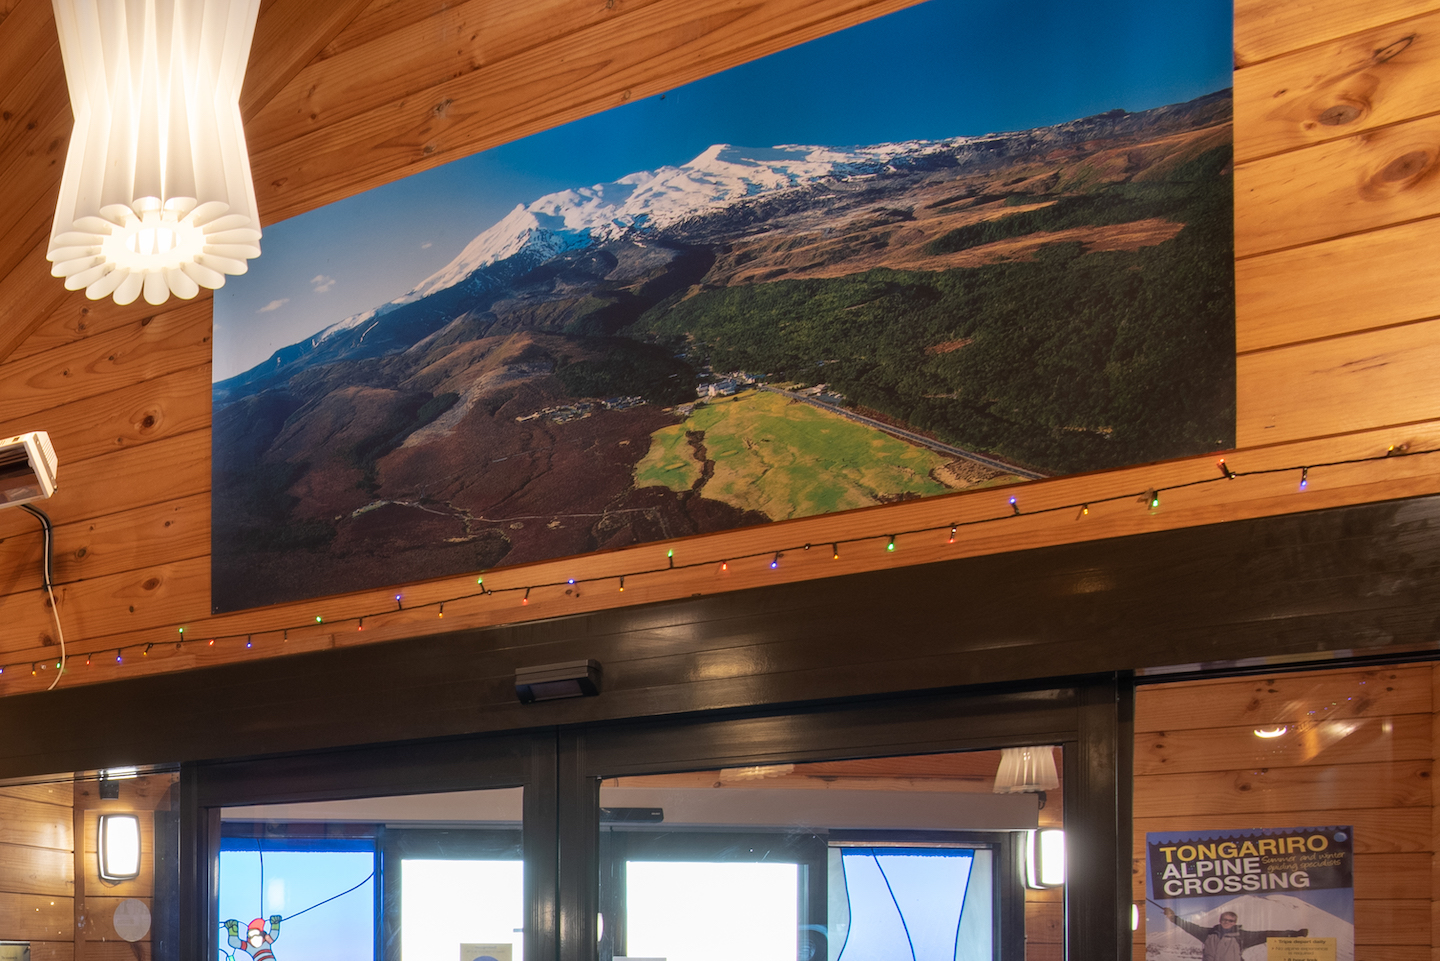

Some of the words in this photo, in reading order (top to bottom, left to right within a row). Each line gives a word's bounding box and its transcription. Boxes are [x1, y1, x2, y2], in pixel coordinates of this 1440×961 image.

[1159, 834, 1329, 864] TONGARIRO
[1261, 855, 1297, 865] Summer
[1299, 853, 1317, 862] and
[1318, 851, 1346, 860] winter
[1162, 857, 1262, 881] ALPINE
[1267, 862, 1299, 873] guiding
[1300, 859, 1342, 870] specialists
[1163, 871, 1311, 898] CROSSING
